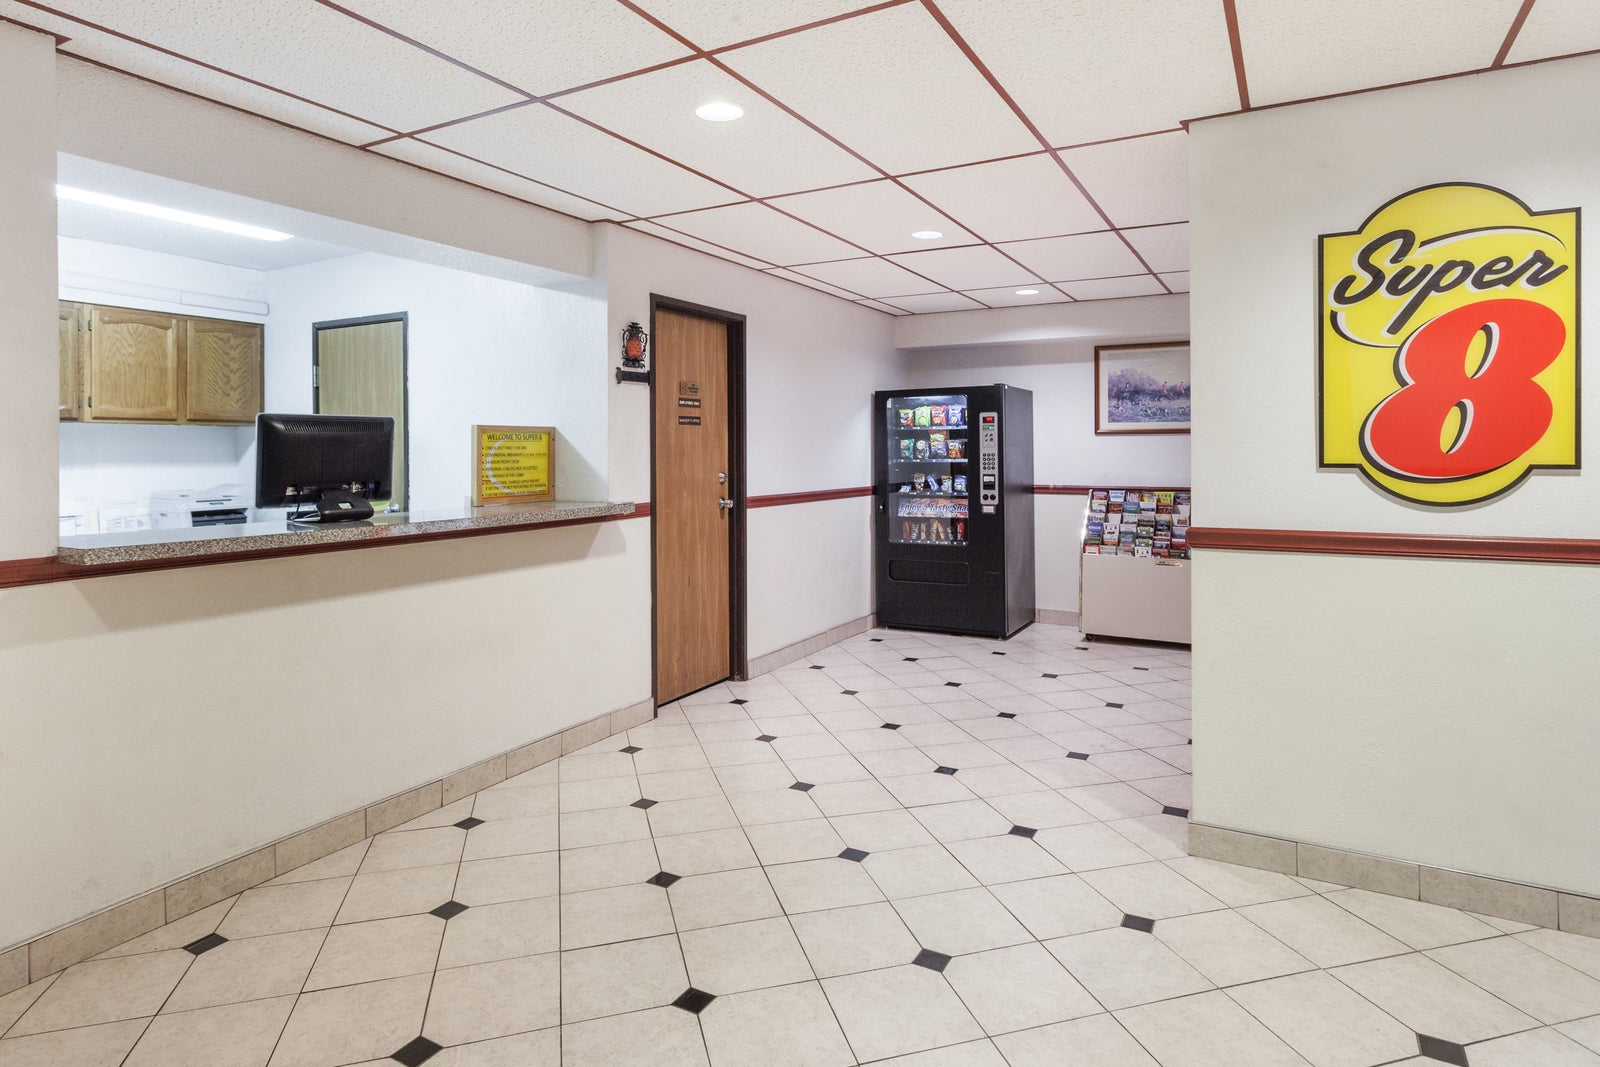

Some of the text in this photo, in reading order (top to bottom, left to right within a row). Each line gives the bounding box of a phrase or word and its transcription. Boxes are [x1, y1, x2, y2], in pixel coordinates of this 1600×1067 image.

[1330, 229, 1569, 336] Super
[487, 433, 514, 441] WELCOME
[515, 433, 522, 441] TO
[522, 433, 539, 441] SUPER
[1359, 298, 1567, 483] 8
